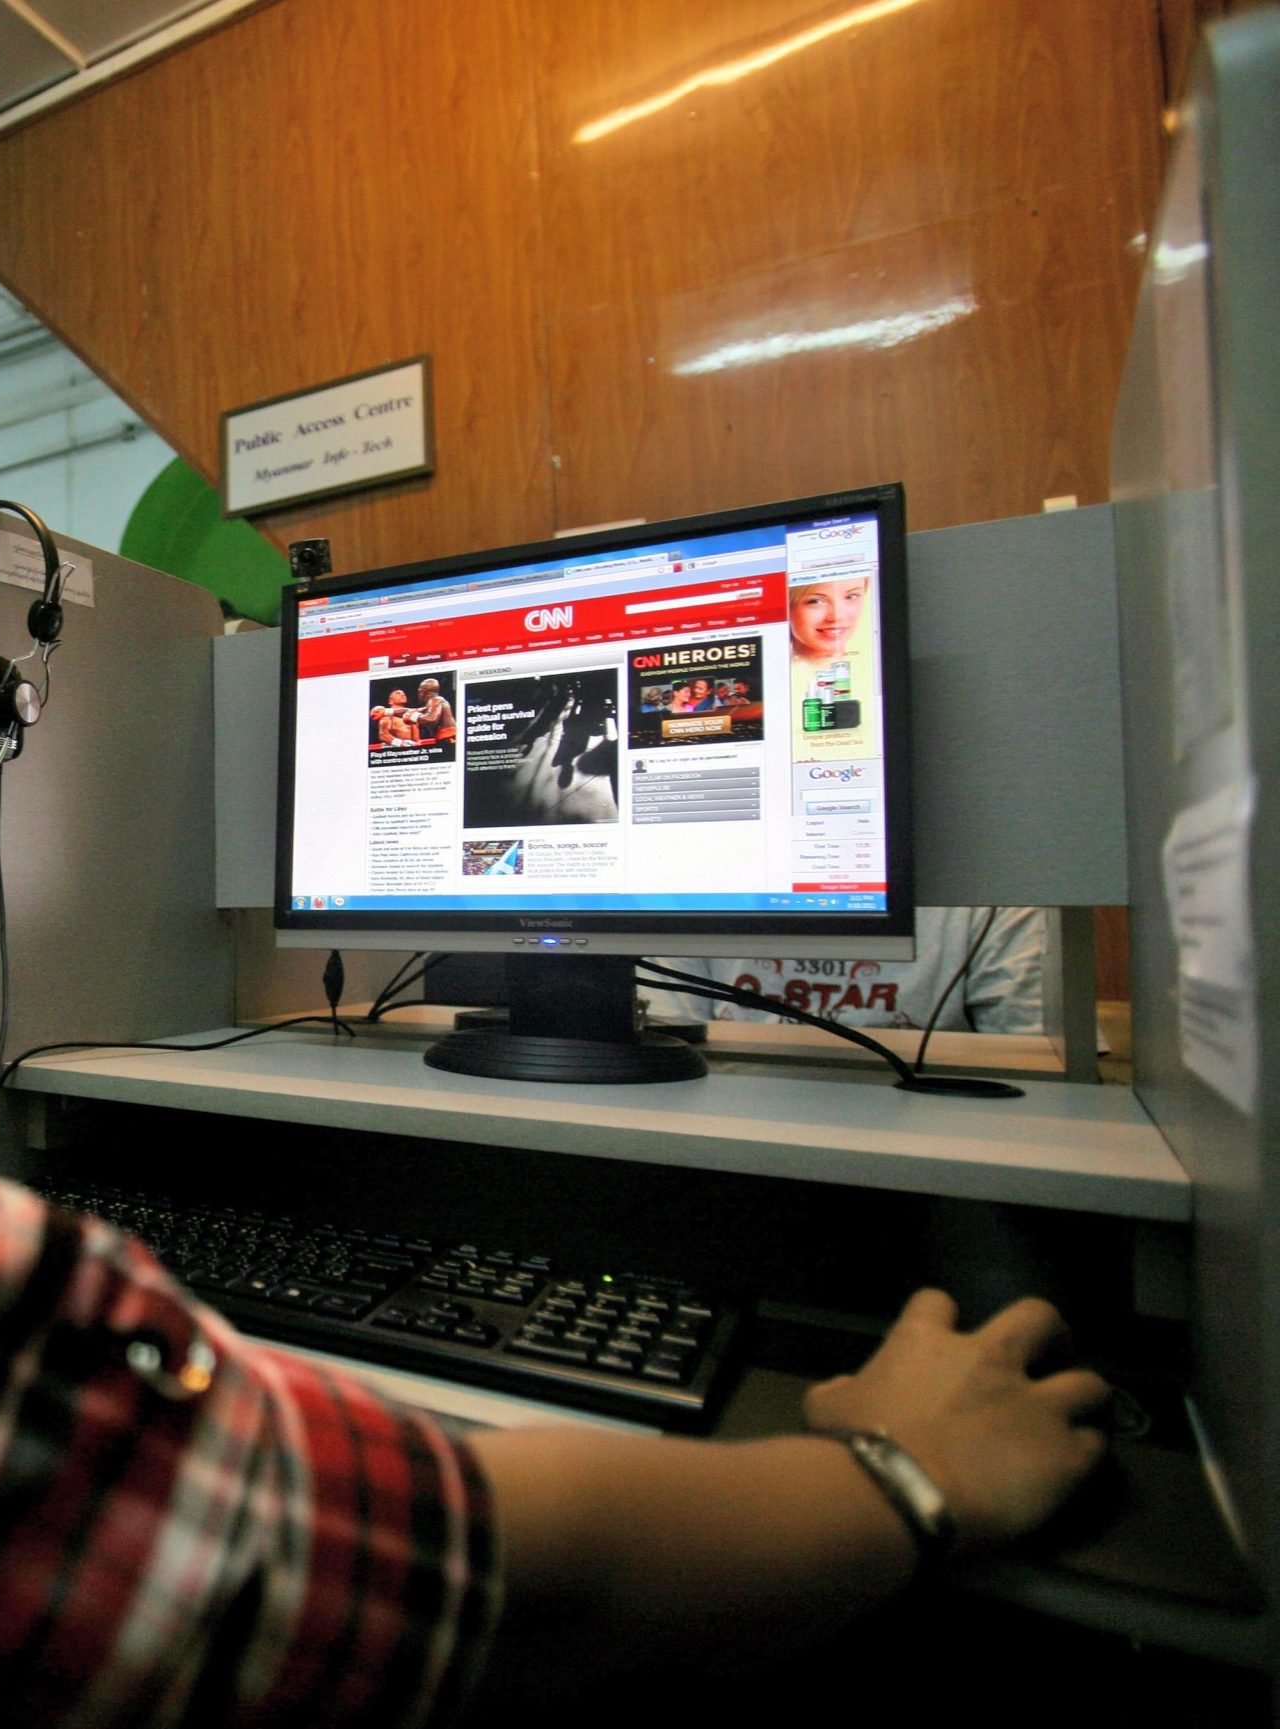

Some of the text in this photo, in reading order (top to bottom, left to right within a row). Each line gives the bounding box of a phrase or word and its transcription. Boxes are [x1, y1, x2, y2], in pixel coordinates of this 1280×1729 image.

[234, 396, 413, 454] Public Access Centre
[254, 458, 314, 482] Myanmar
[819, 525, 864, 539] Google
[524, 605, 573, 633] CNN
[633, 654, 661, 669] CNN
[663, 644, 750, 666] HEROES
[479, 667, 512, 675] WEEKEND
[467, 702, 514, 713] Priest pens
[467, 710, 535, 724] spiritual survival
[467, 723, 505, 735] guide for
[467, 733, 507, 742] recession
[370, 751, 387, 759] Floyd
[387, 749, 420, 757] Mayweather
[809, 765, 863, 782] Google
[520, 918, 573, 928] ViewSonic
[793, 959, 847, 976] 3301
